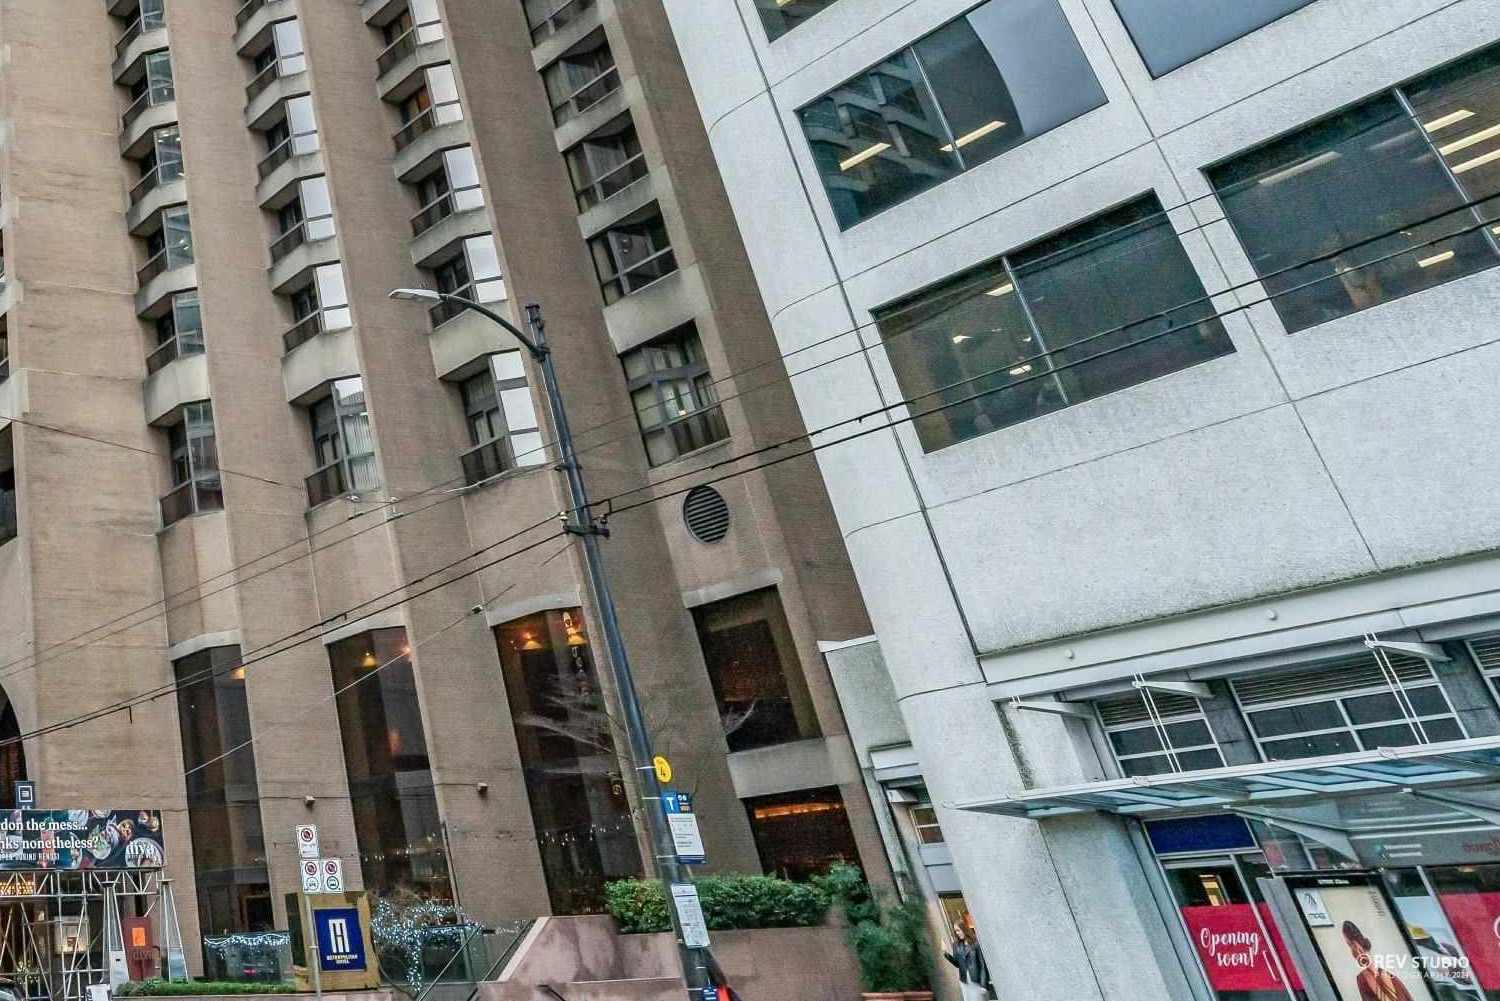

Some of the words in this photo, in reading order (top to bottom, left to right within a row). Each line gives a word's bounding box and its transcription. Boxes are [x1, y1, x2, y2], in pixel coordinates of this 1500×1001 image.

[26, 818, 45, 831] the
[48, 820, 88, 831] mess...
[22, 837, 98, 849] nonetheless?
[1200, 927, 1258, 957] Opening
[1216, 947, 1254, 968] soon!
